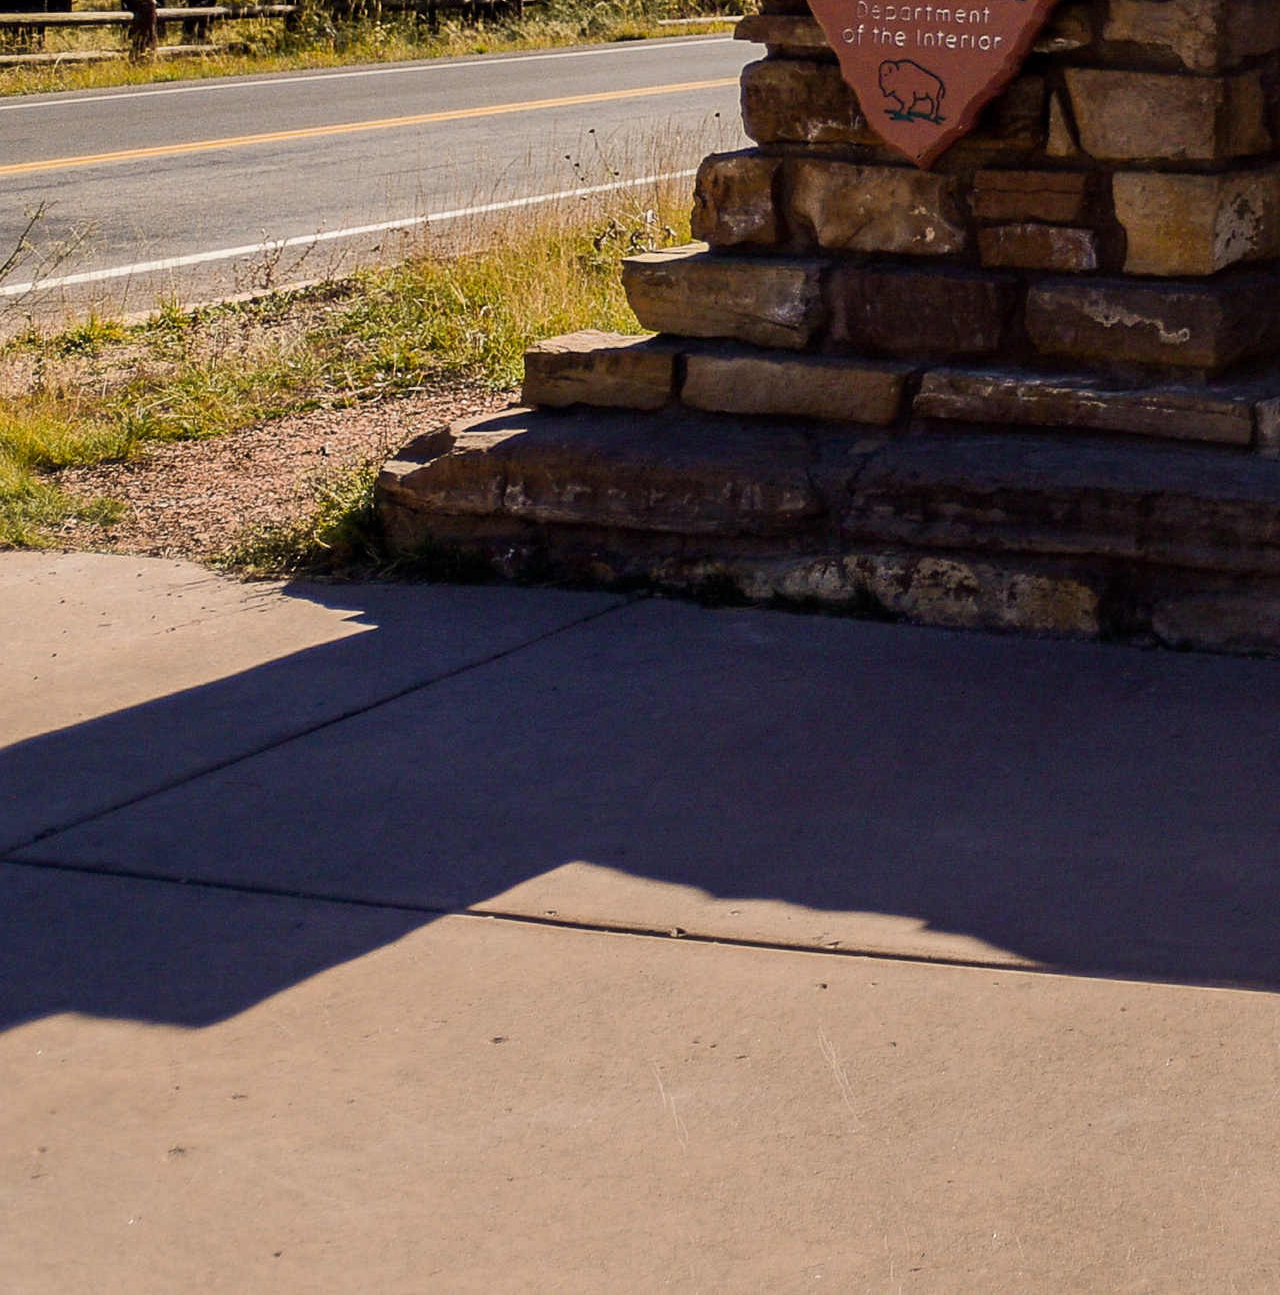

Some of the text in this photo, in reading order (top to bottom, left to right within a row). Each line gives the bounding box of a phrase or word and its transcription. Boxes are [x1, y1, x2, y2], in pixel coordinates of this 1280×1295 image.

[856, 0, 990, 24] Department
[842, 24, 1003, 51] of the Interior
